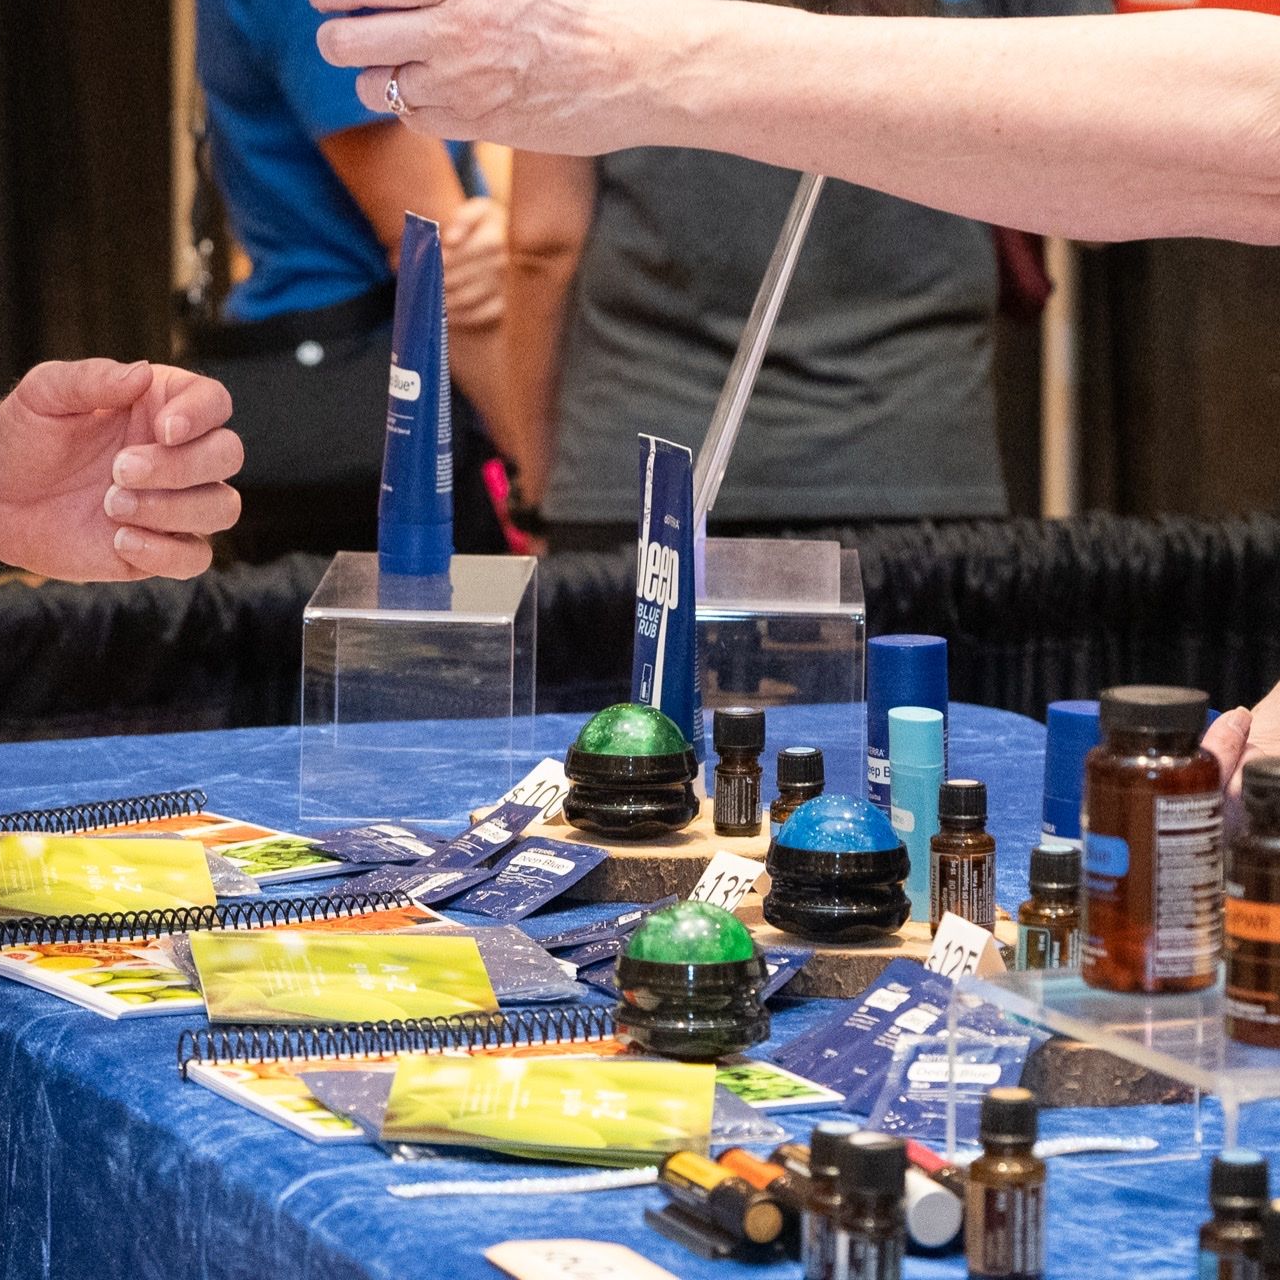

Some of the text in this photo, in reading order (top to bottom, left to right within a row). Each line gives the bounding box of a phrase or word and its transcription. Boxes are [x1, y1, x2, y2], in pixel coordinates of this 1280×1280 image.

[637, 602, 661, 624] BLUE
[638, 620, 658, 639] RUB
[512, 853, 567, 871] Deep Blue
[962, 858, 970, 891] Supplement
